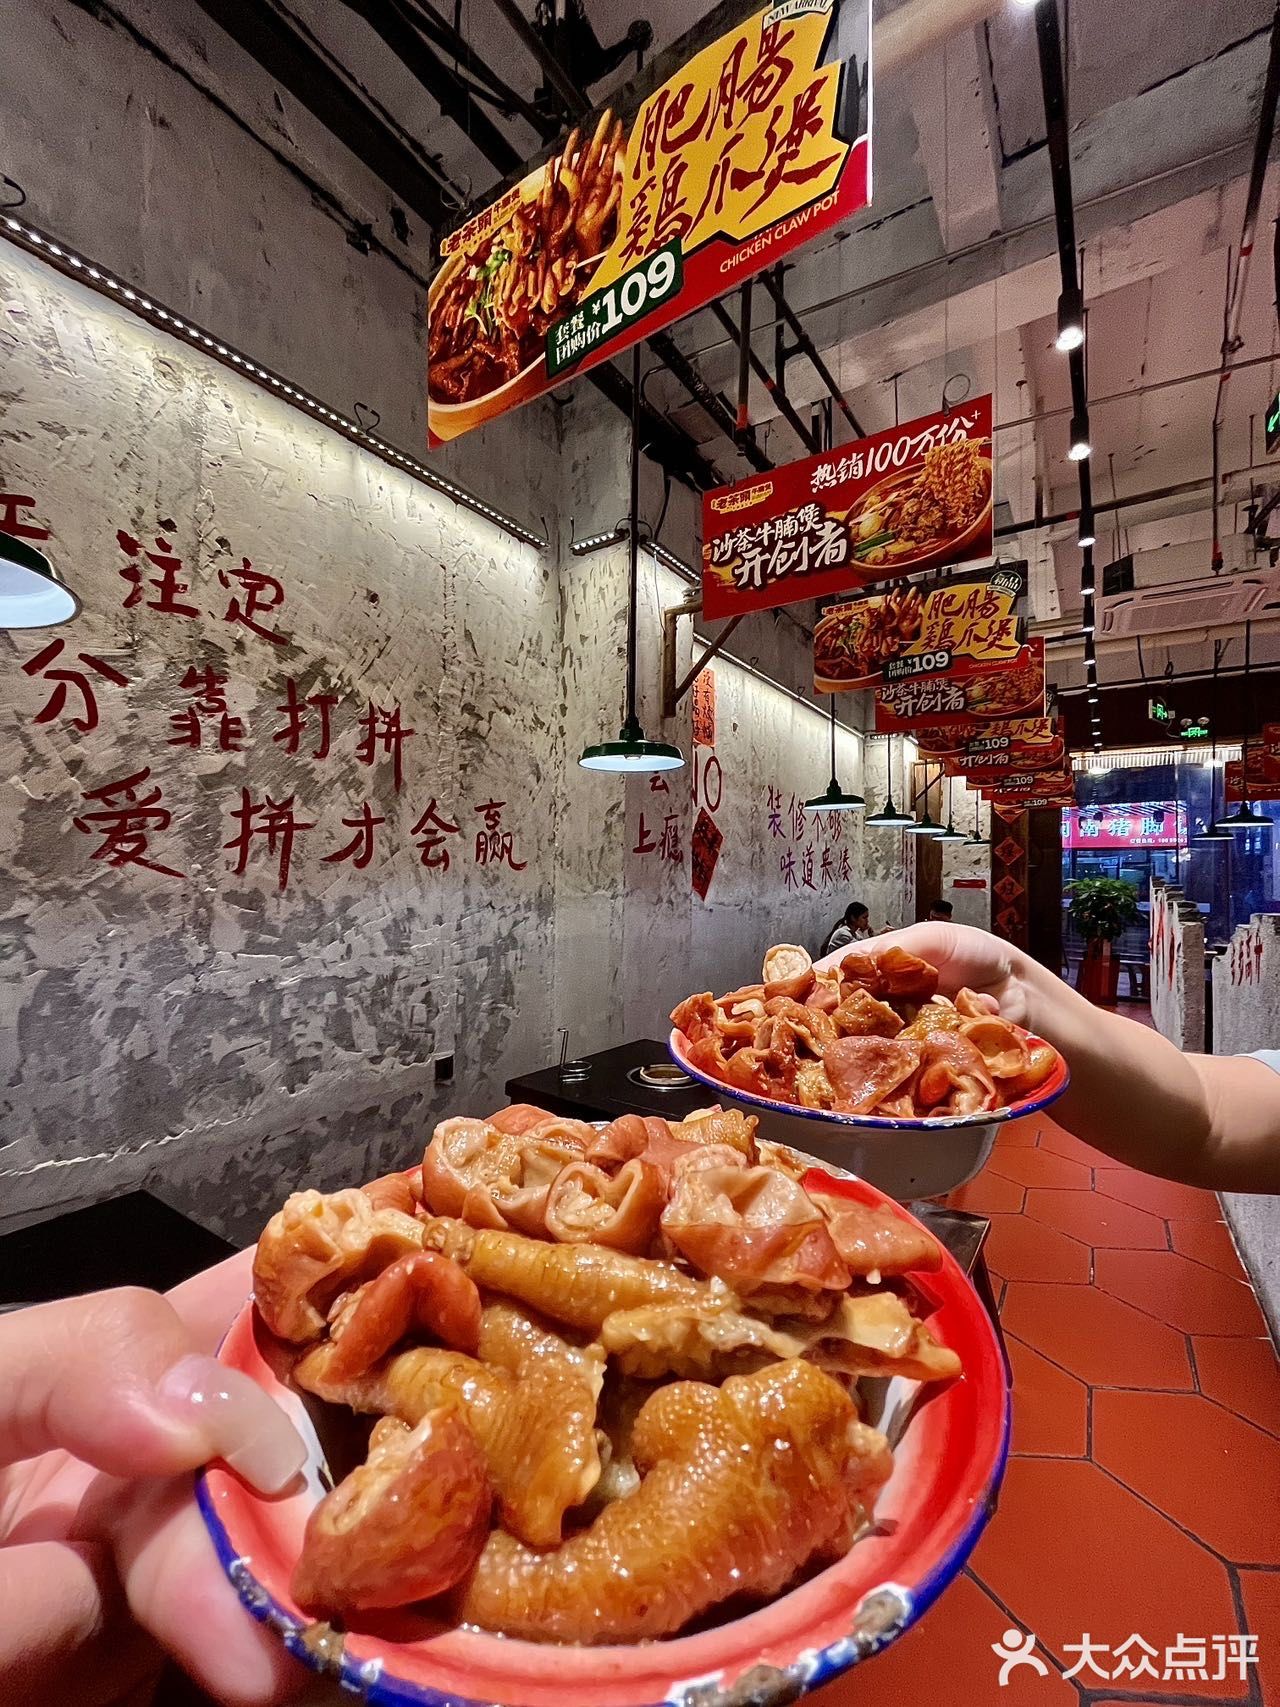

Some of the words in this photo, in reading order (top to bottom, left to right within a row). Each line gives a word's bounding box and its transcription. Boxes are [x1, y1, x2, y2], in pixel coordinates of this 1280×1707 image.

[719, 233, 772, 273] CHICKEN
[774, 207, 811, 240] CLAW
[813, 190, 839, 217] POT
[556, 322, 601, 365] 团购价
[712, 503, 823, 562] 沙茶牛腩煲
[735, 521, 847, 587] 开创者
[895, 687, 964, 716] 开创者
[74, 766, 527, 891] 爱拼才会赢
[780, 840, 853, 892] 味道来凑
